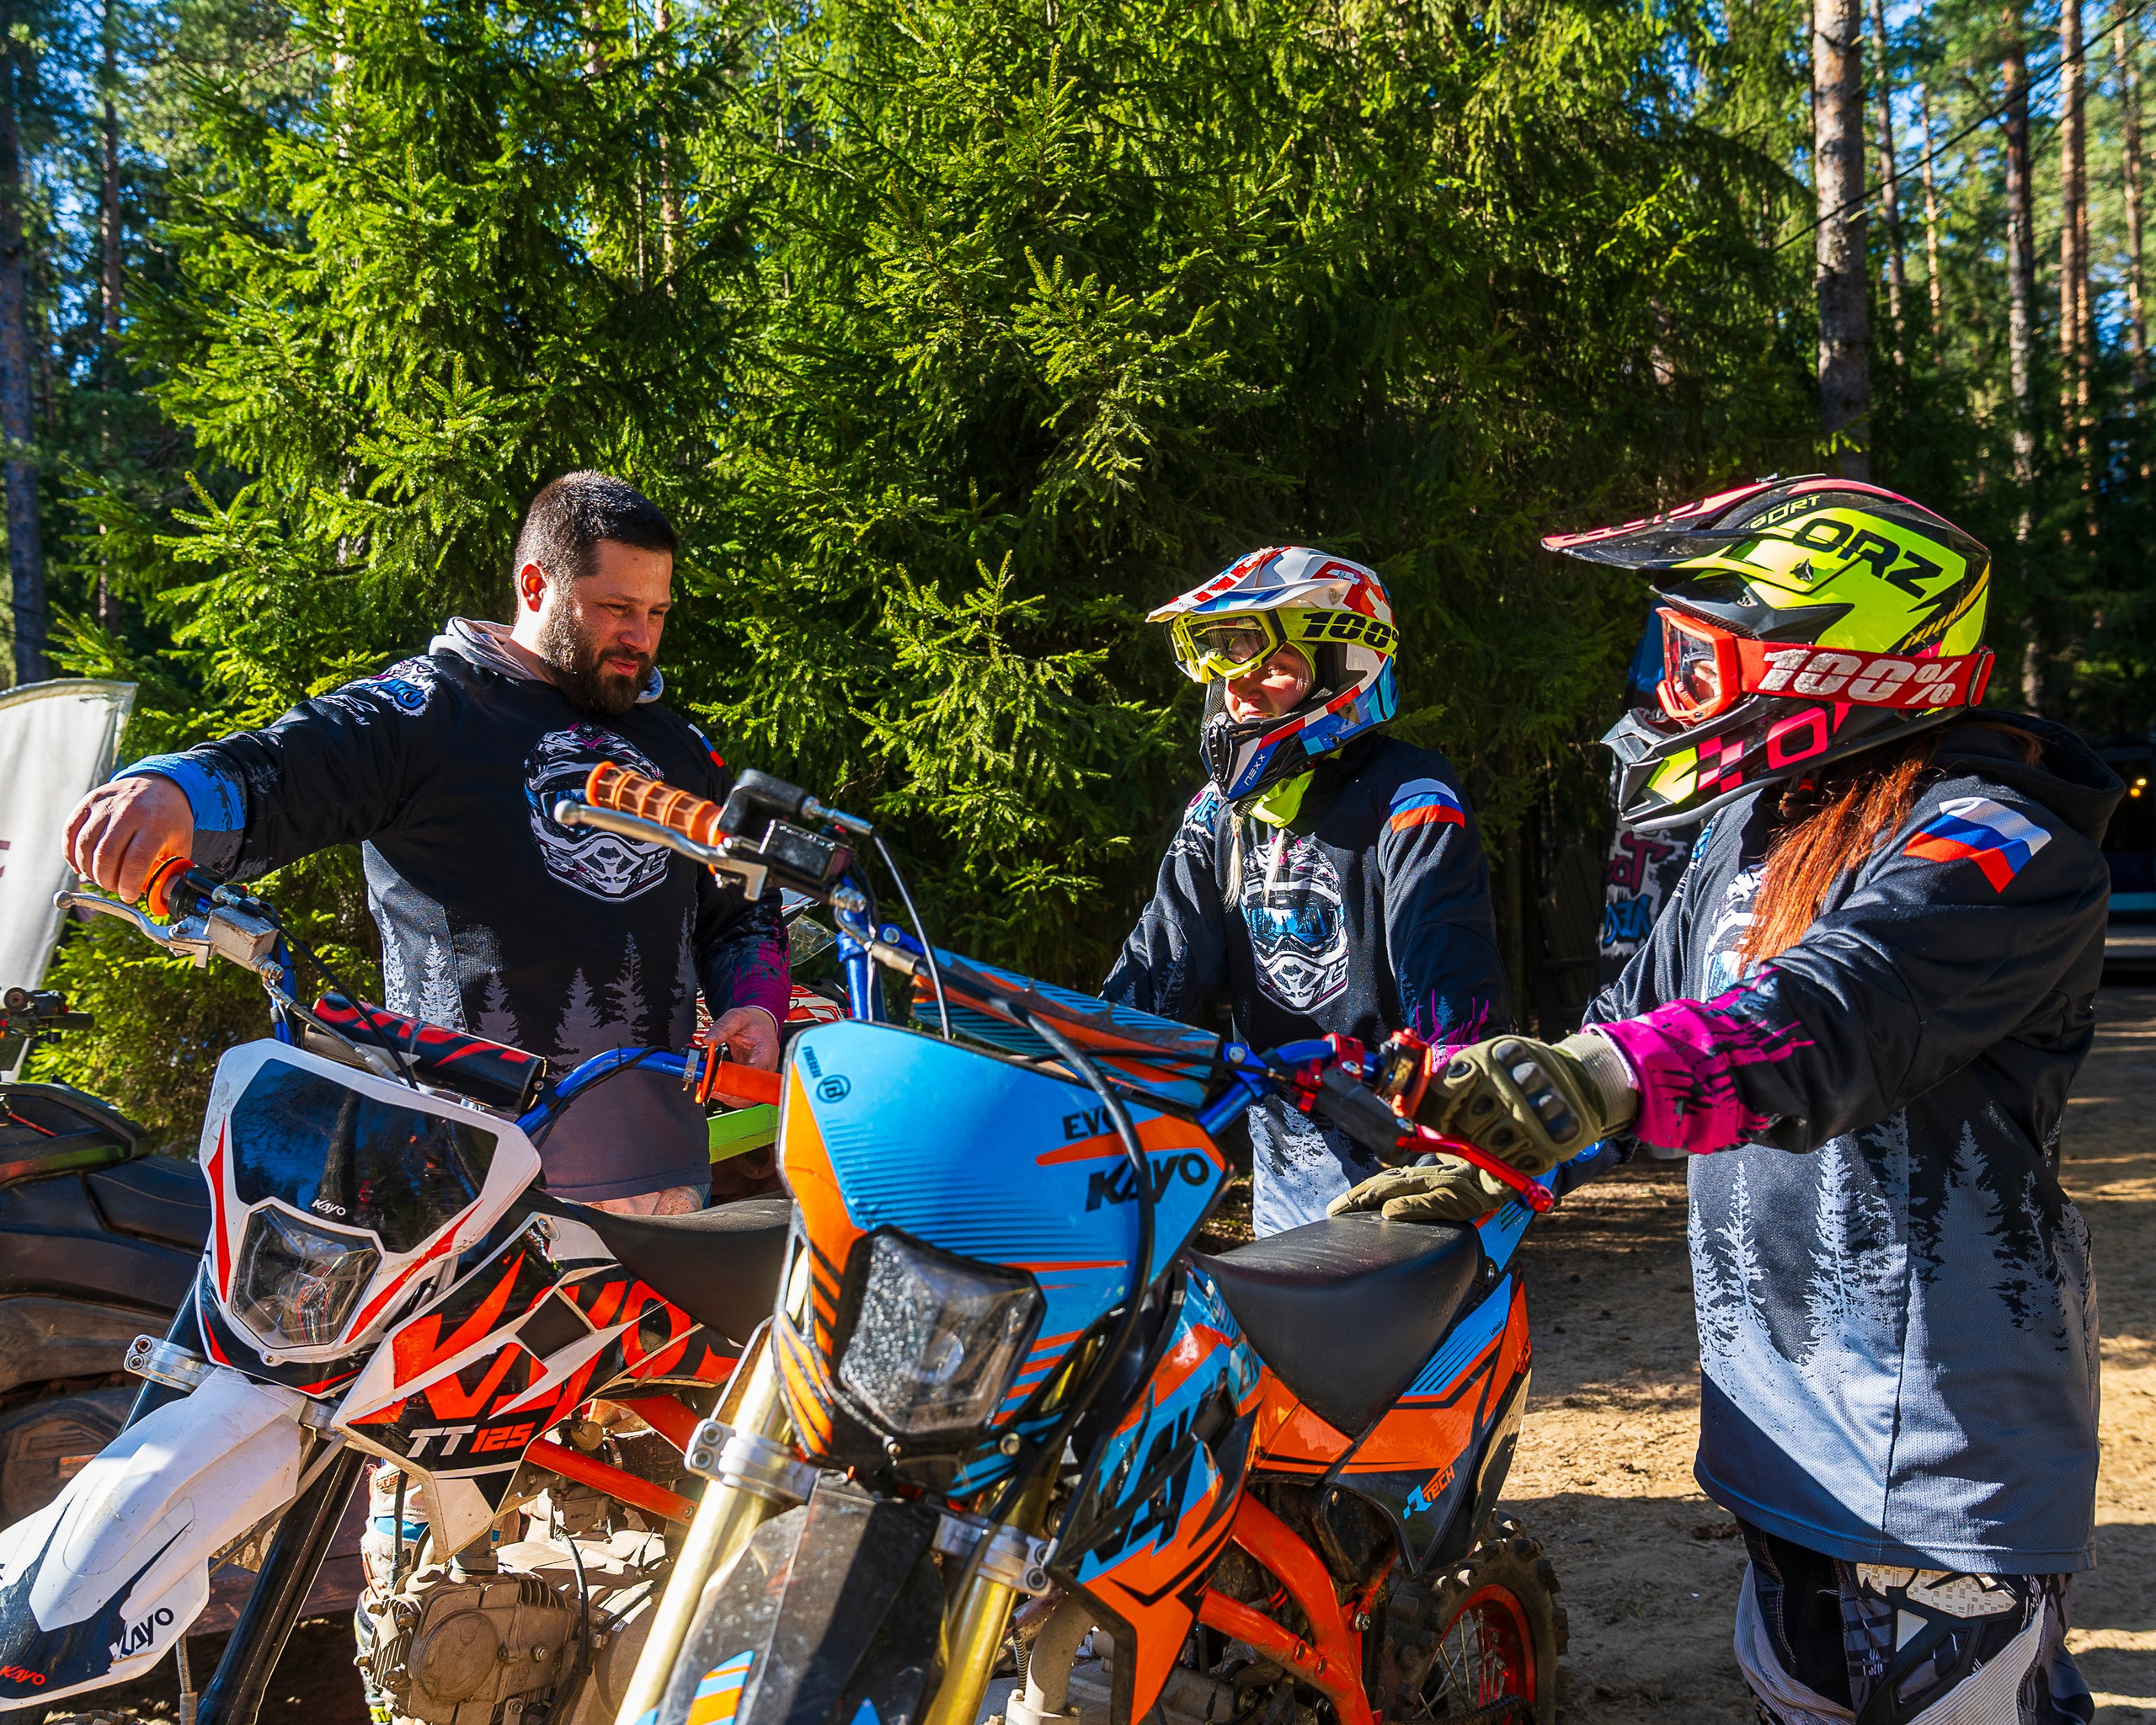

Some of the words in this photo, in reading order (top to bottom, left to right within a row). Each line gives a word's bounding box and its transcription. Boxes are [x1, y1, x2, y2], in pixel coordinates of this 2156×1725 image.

[1745, 494, 1821, 530] PORT
[1302, 611, 1399, 649] 100
[1760, 648, 1963, 705] 100%
[312, 1199, 346, 1216] KAYO
[406, 1424, 476, 1458] TT
[470, 1423, 536, 1454] 125
[109, 1607, 174, 1660] KAYO
[0, 1665, 46, 1685] KAYO
